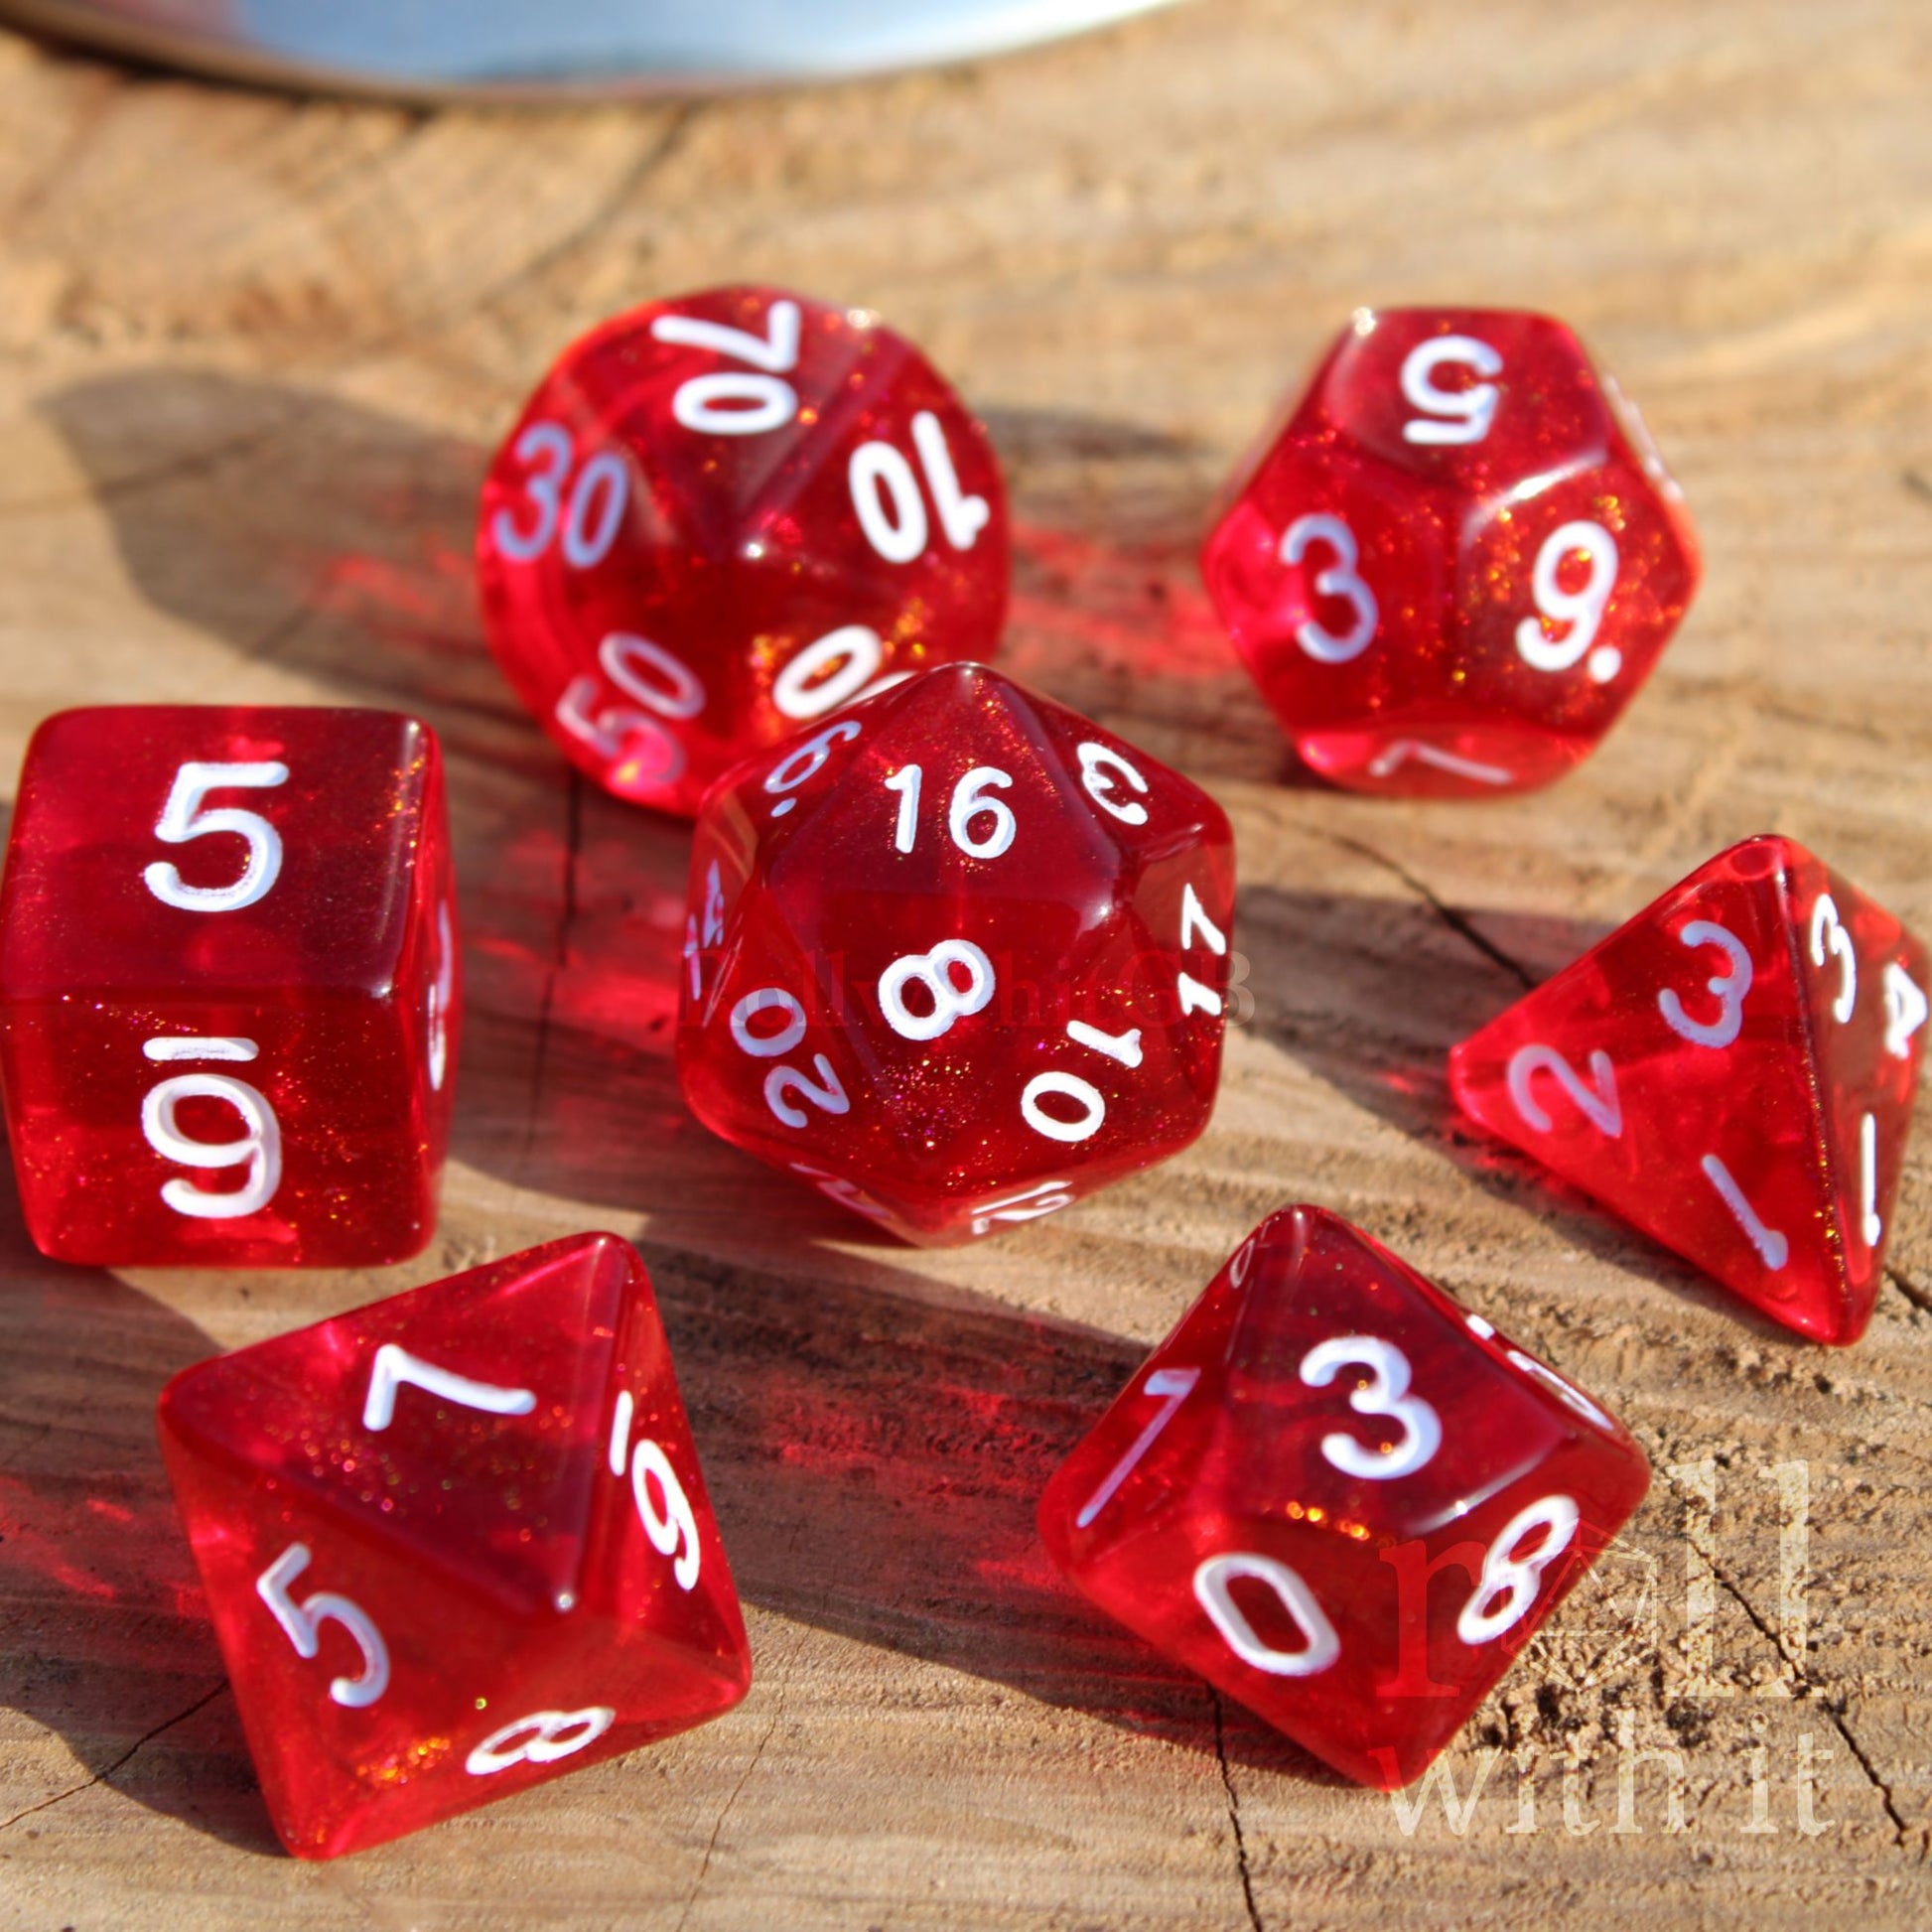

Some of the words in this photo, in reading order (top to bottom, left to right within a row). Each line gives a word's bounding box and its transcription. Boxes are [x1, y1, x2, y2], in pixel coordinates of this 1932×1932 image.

[650, 300, 800, 435] 70
[1400, 334, 1503, 445] 5
[494, 421, 629, 569] 30
[847, 410, 991, 564] 10
[1279, 512, 1379, 664] 3
[555, 631, 705, 792] 50
[143, 760, 290, 912] 5
[886, 763, 1017, 859] 16
[1076, 742, 1149, 826] 3
[878, 938, 996, 1041] 8
[1658, 919, 1753, 1049] 3
[1811, 893, 1857, 1024] 3
[730, 987, 850, 1129] 20
[1021, 1020, 1143, 1142] 10
[1506, 1043, 1623, 1139] 2
[1701, 1154, 1788, 1271] 1
[1861, 1112, 1881, 1247] 1
[361, 1342, 537, 1432] 7
[1299, 1334, 1443, 1480] 3
[256, 1542, 391, 1710] 5
[1192, 1551, 1341, 1677] 0
[1456, 1494, 1581, 1645] 8
[465, 1706, 617, 1776] 8
